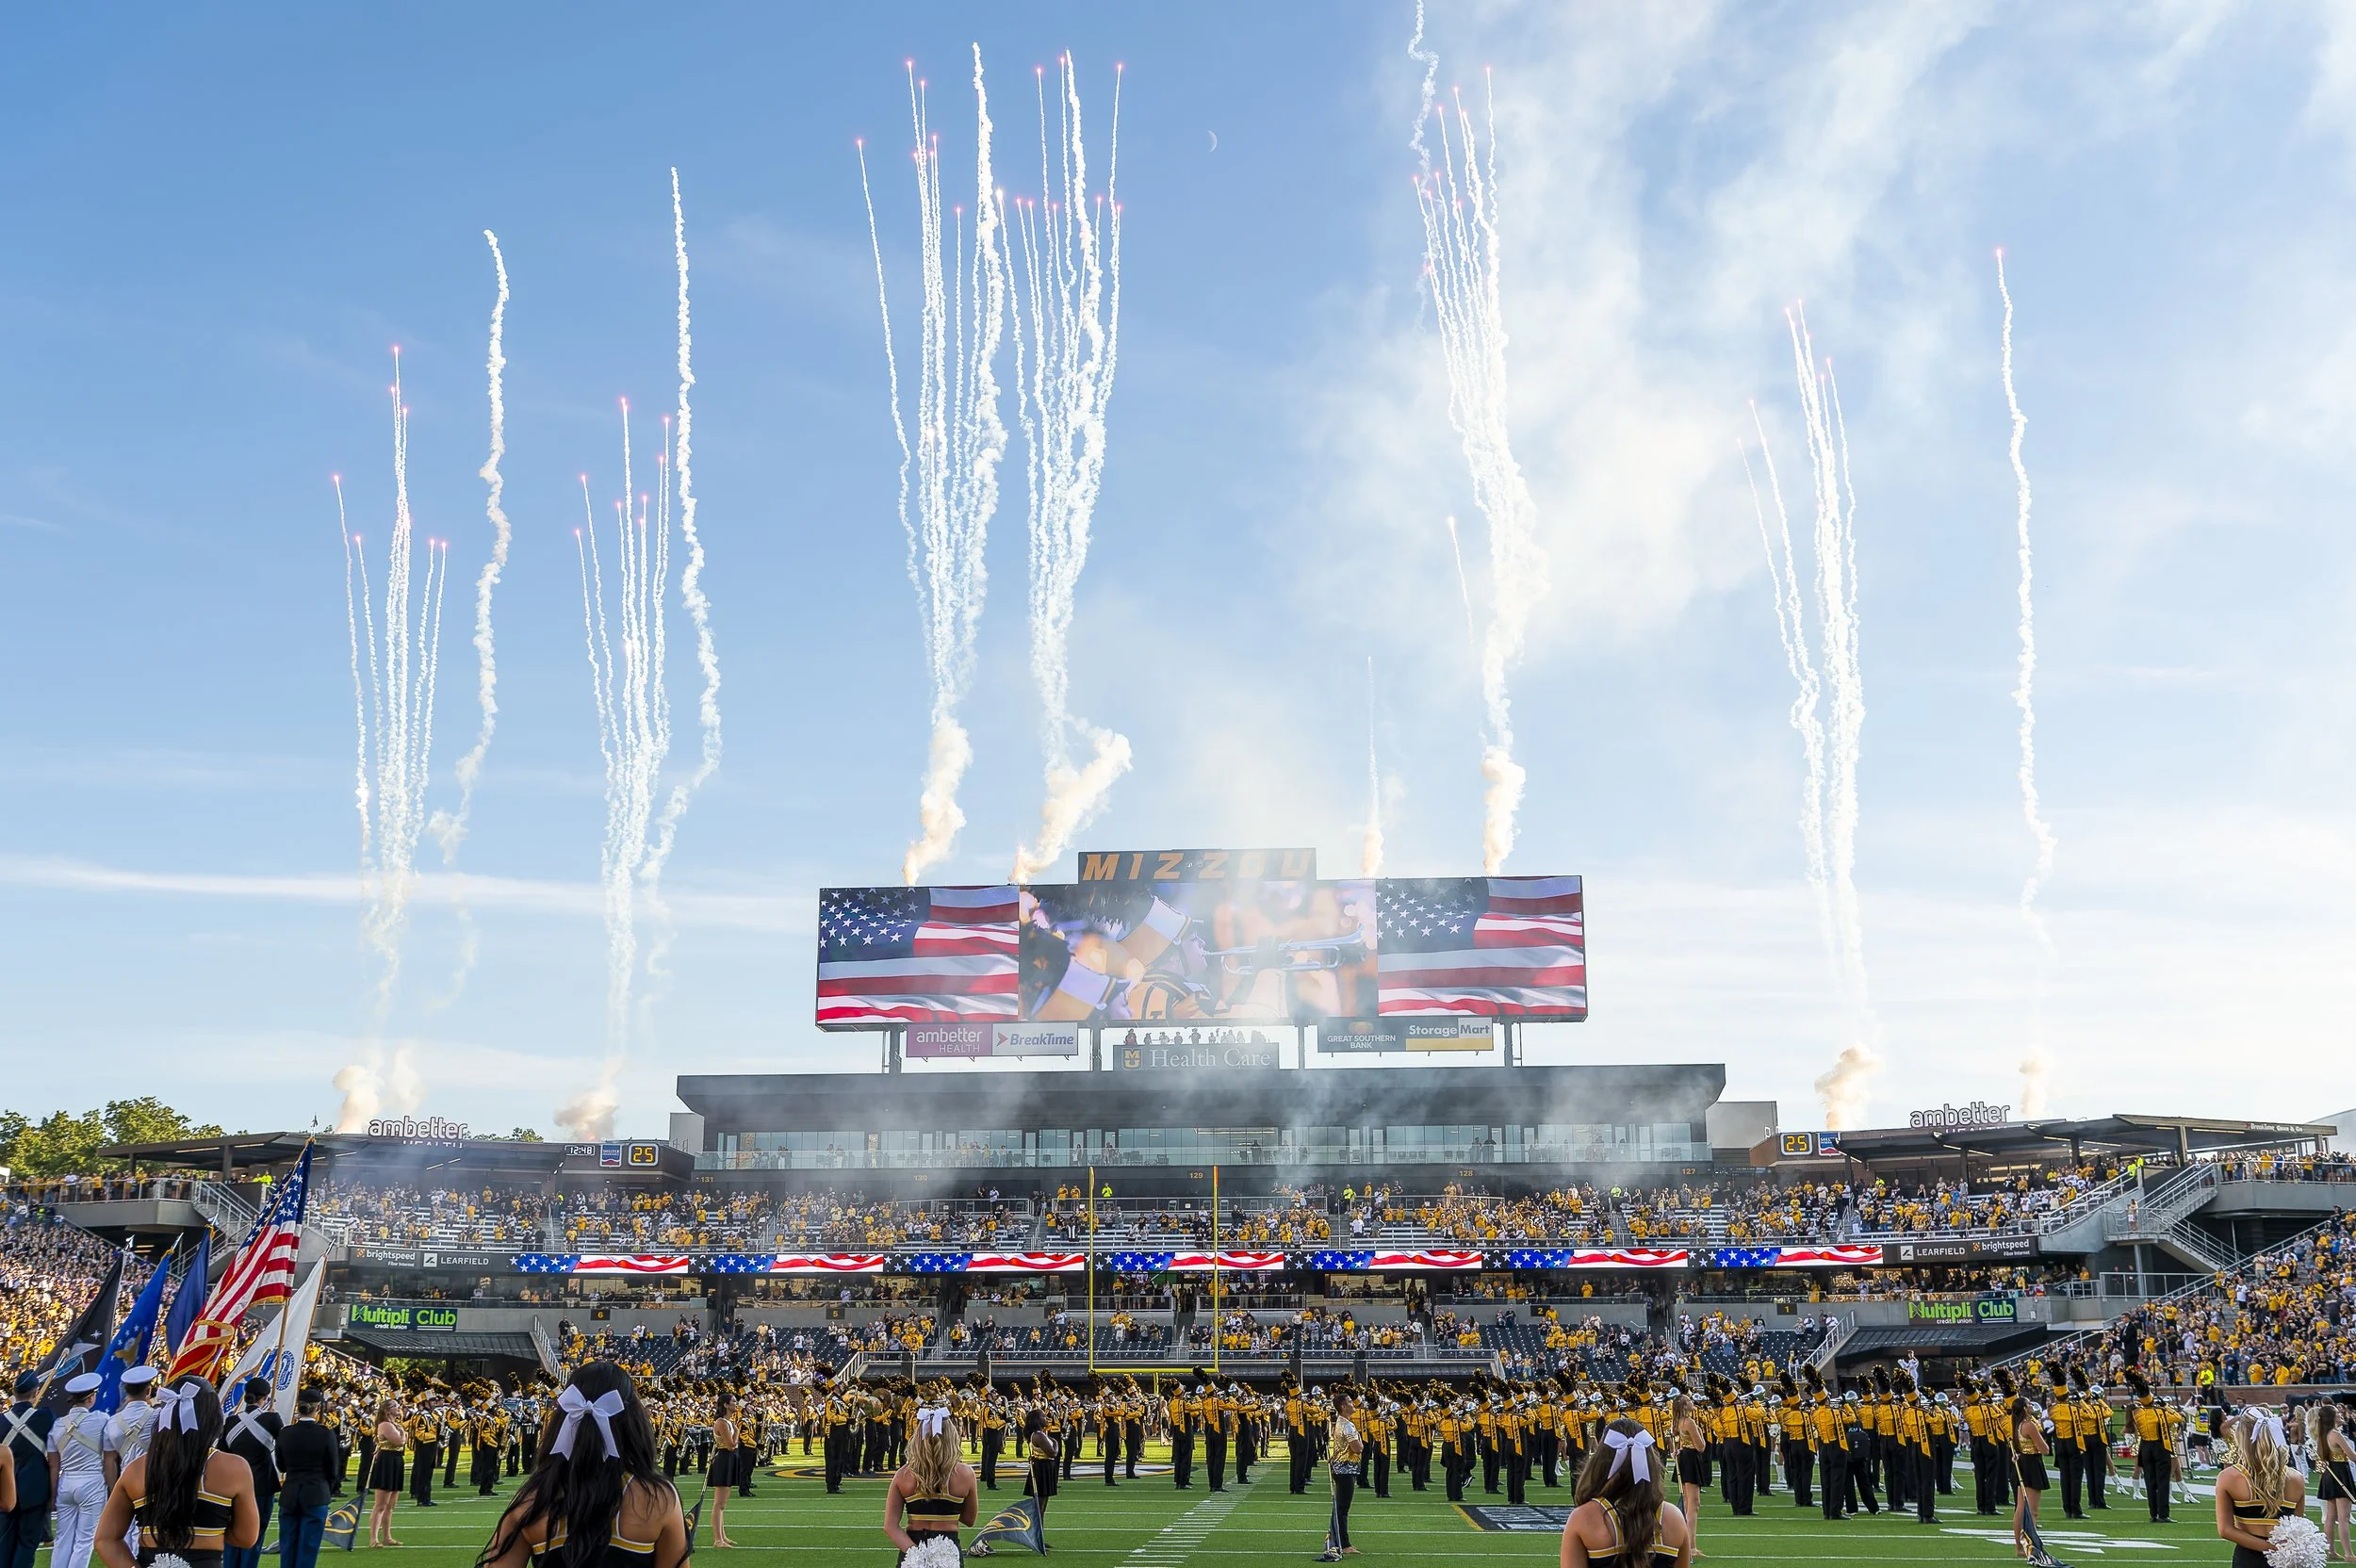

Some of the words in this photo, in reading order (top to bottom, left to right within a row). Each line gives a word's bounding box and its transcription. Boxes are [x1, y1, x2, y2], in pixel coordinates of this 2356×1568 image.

[1082, 852, 1312, 881] MIZZOU
[916, 1029, 983, 1043] ambetter
[1009, 1033, 1074, 1046] BreakTime
[939, 1044, 980, 1054] HEALTH
[1150, 1046, 1219, 1068] Health
[1224, 1046, 1271, 1068] Care
[1909, 1101, 2010, 1128] ambetter
[368, 1115, 467, 1139] ambetter
[570, 1146, 593, 1154] 12:48
[1786, 1135, 1808, 1152] 25
[632, 1147, 654, 1163] 25
[1916, 1247, 1965, 1256] LEARFIELD
[1982, 1239, 2029, 1252] brightspeed
[366, 1250, 416, 1261] brightspeed
[440, 1256, 489, 1266] LEARFIELD
[1978, 1300, 2014, 1317] Club
[417, 1310, 456, 1326] Club
